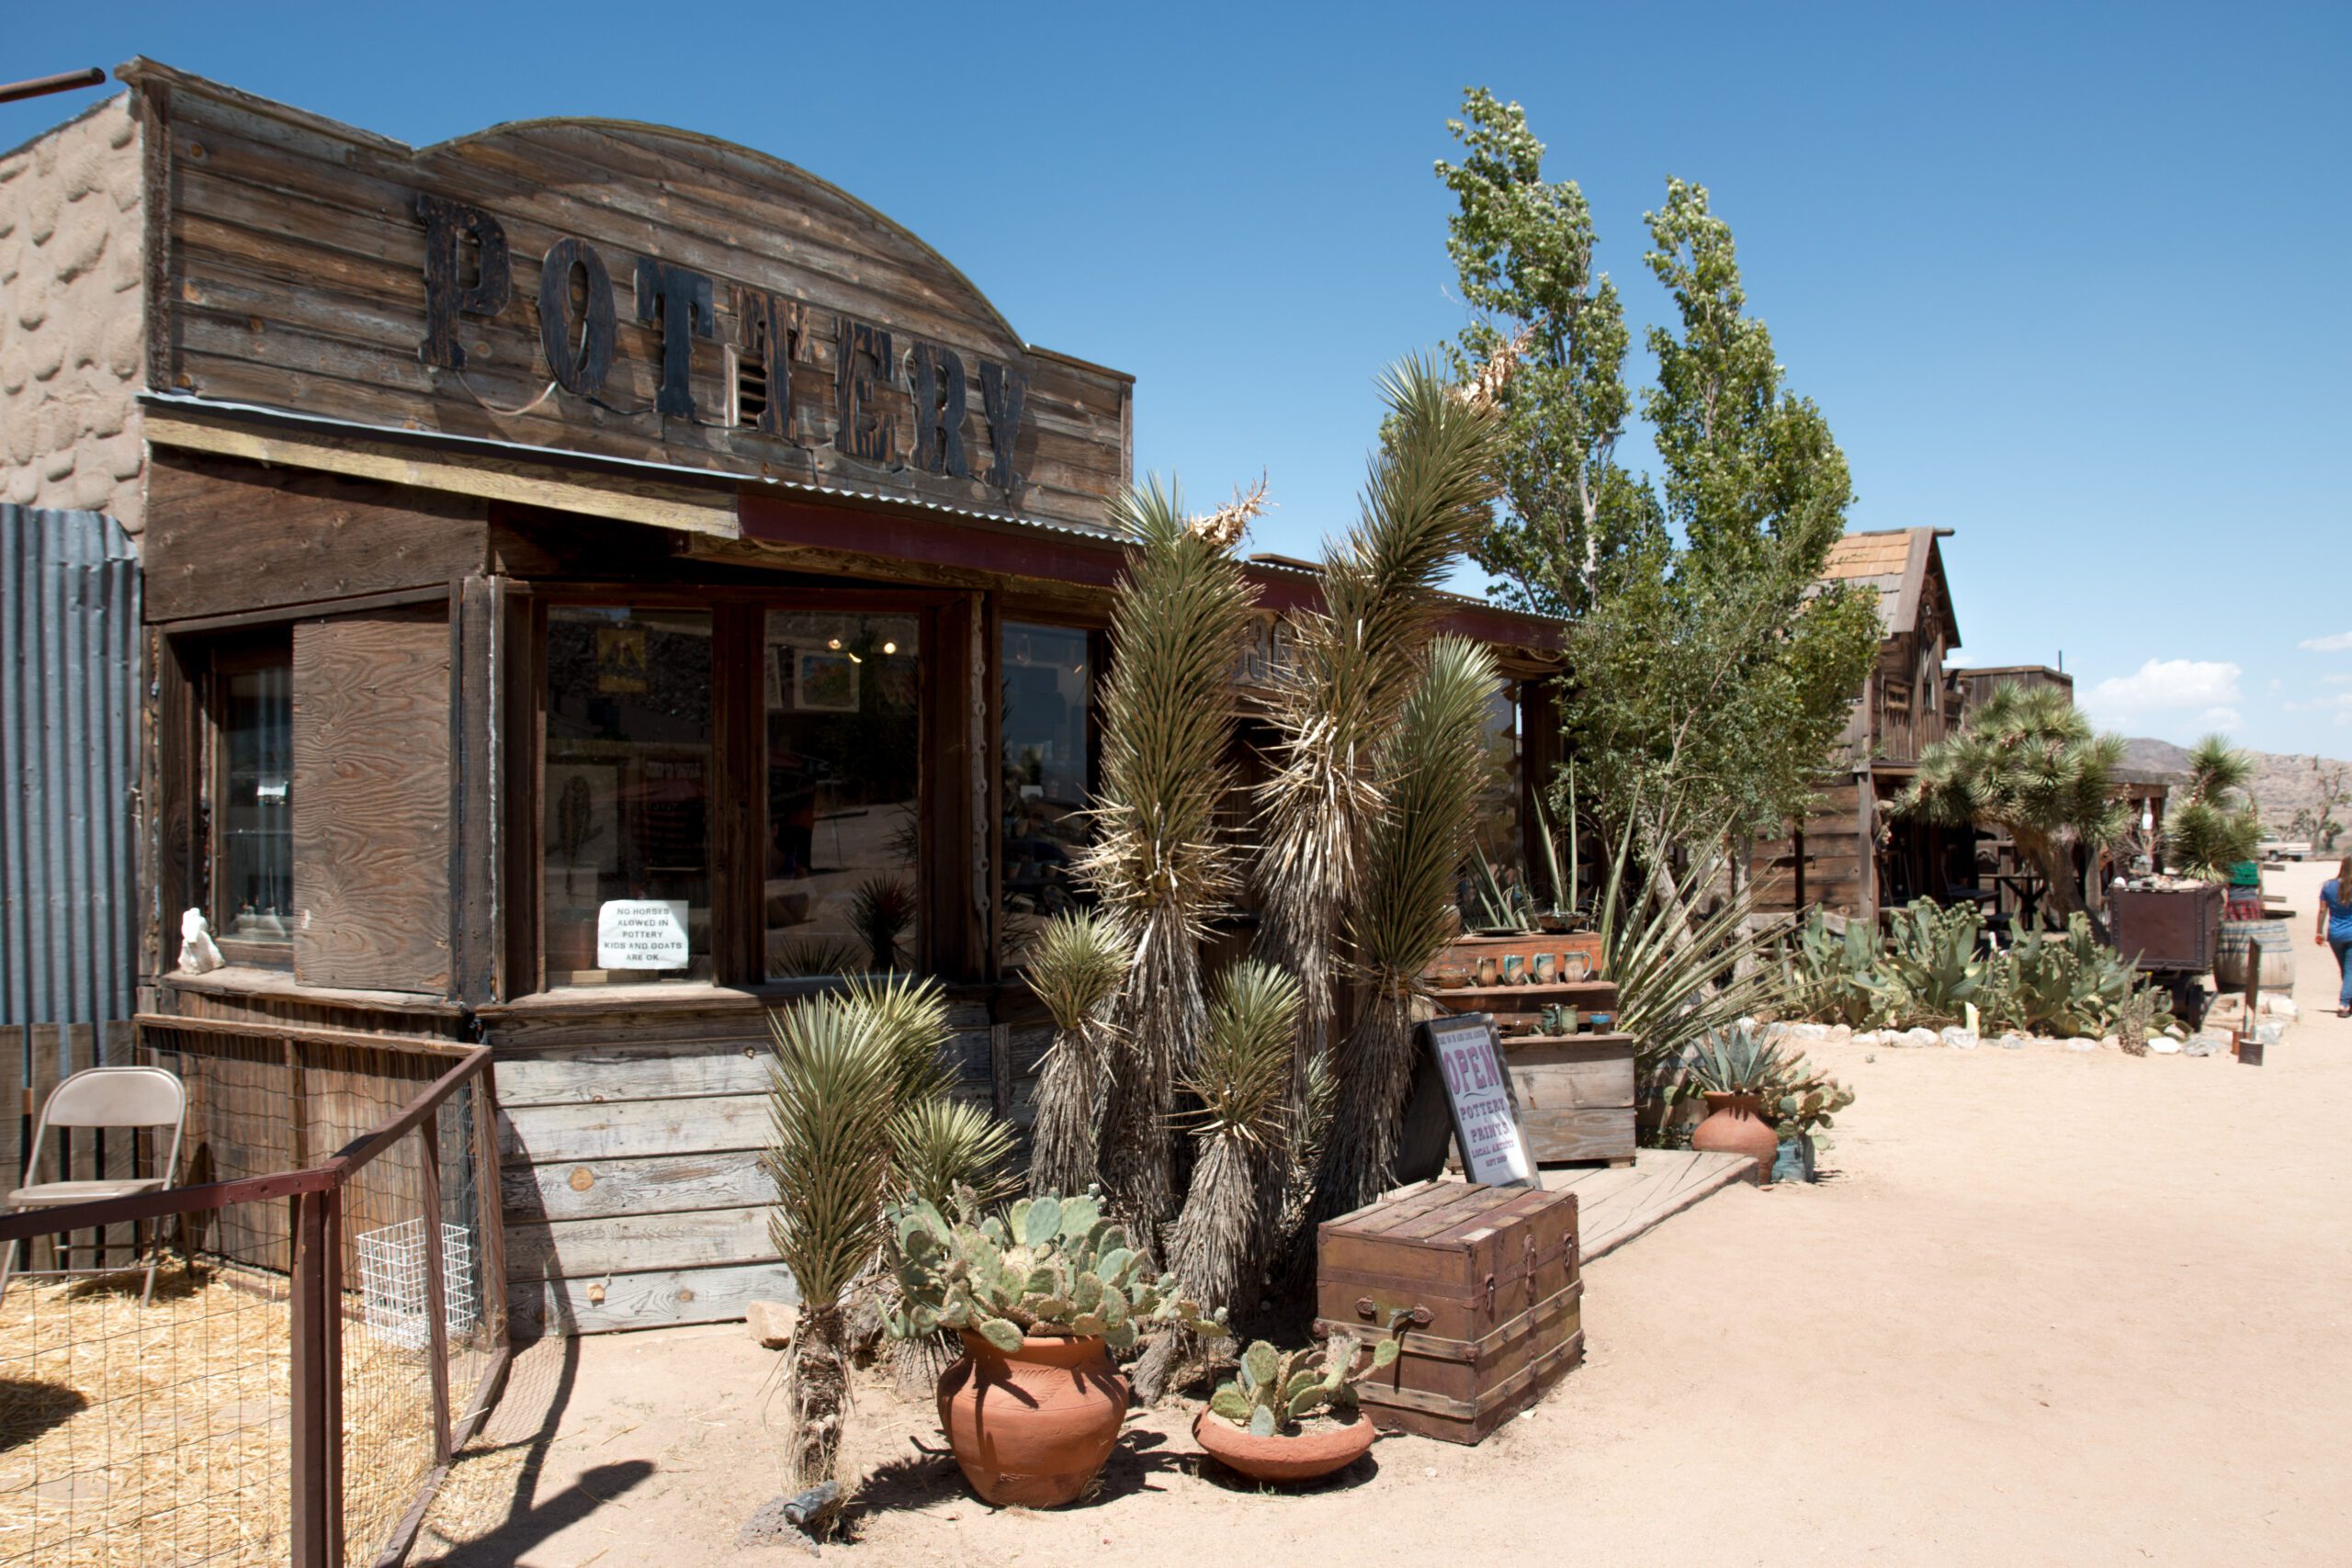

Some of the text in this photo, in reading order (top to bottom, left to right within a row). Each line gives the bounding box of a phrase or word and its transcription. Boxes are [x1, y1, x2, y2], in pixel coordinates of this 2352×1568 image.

[417, 192, 1030, 491] POTTERY
[1443, 1043, 1500, 1095] OPEN
[1459, 1098, 1506, 1121] POTTERY
[1470, 1121, 1509, 1143] PRINTS
[1471, 1145, 1491, 1158] LOCAL
